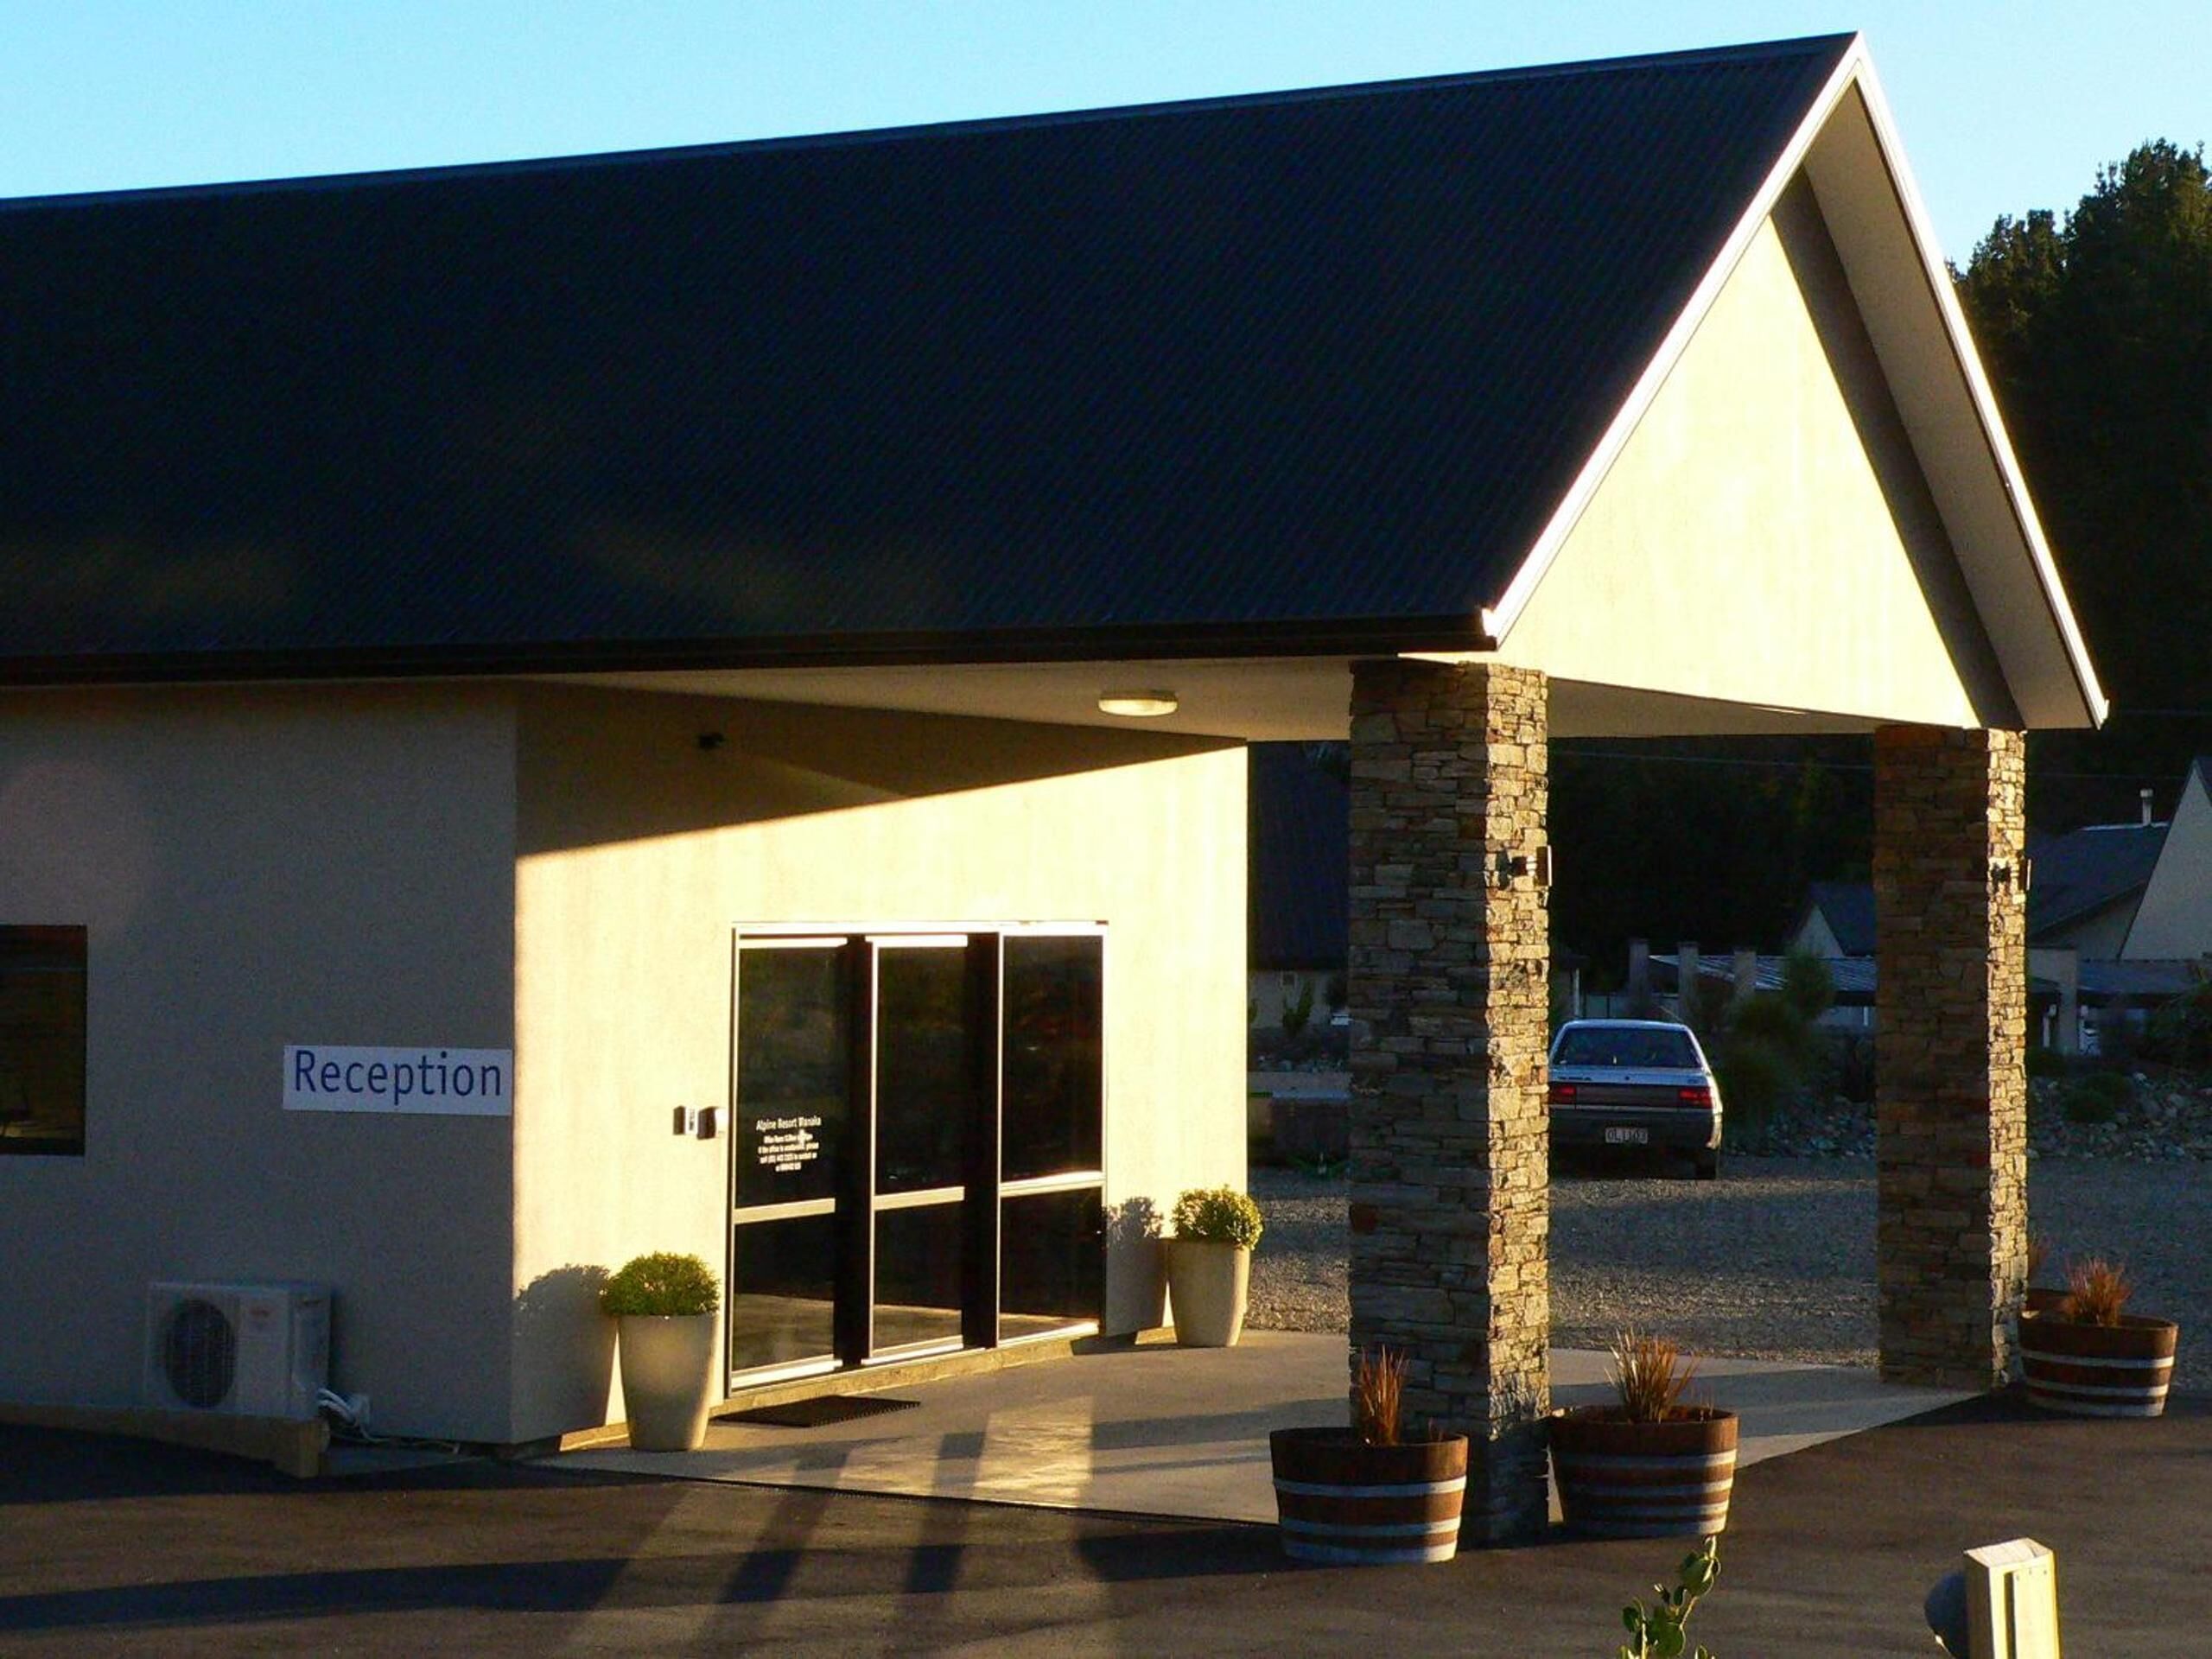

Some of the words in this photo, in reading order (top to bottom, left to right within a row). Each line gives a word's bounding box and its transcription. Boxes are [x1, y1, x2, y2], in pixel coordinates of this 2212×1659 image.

[295, 1049, 501, 1106] Reception
[756, 1120, 776, 1132] Alpine
[778, 1118, 797, 1128] Resort
